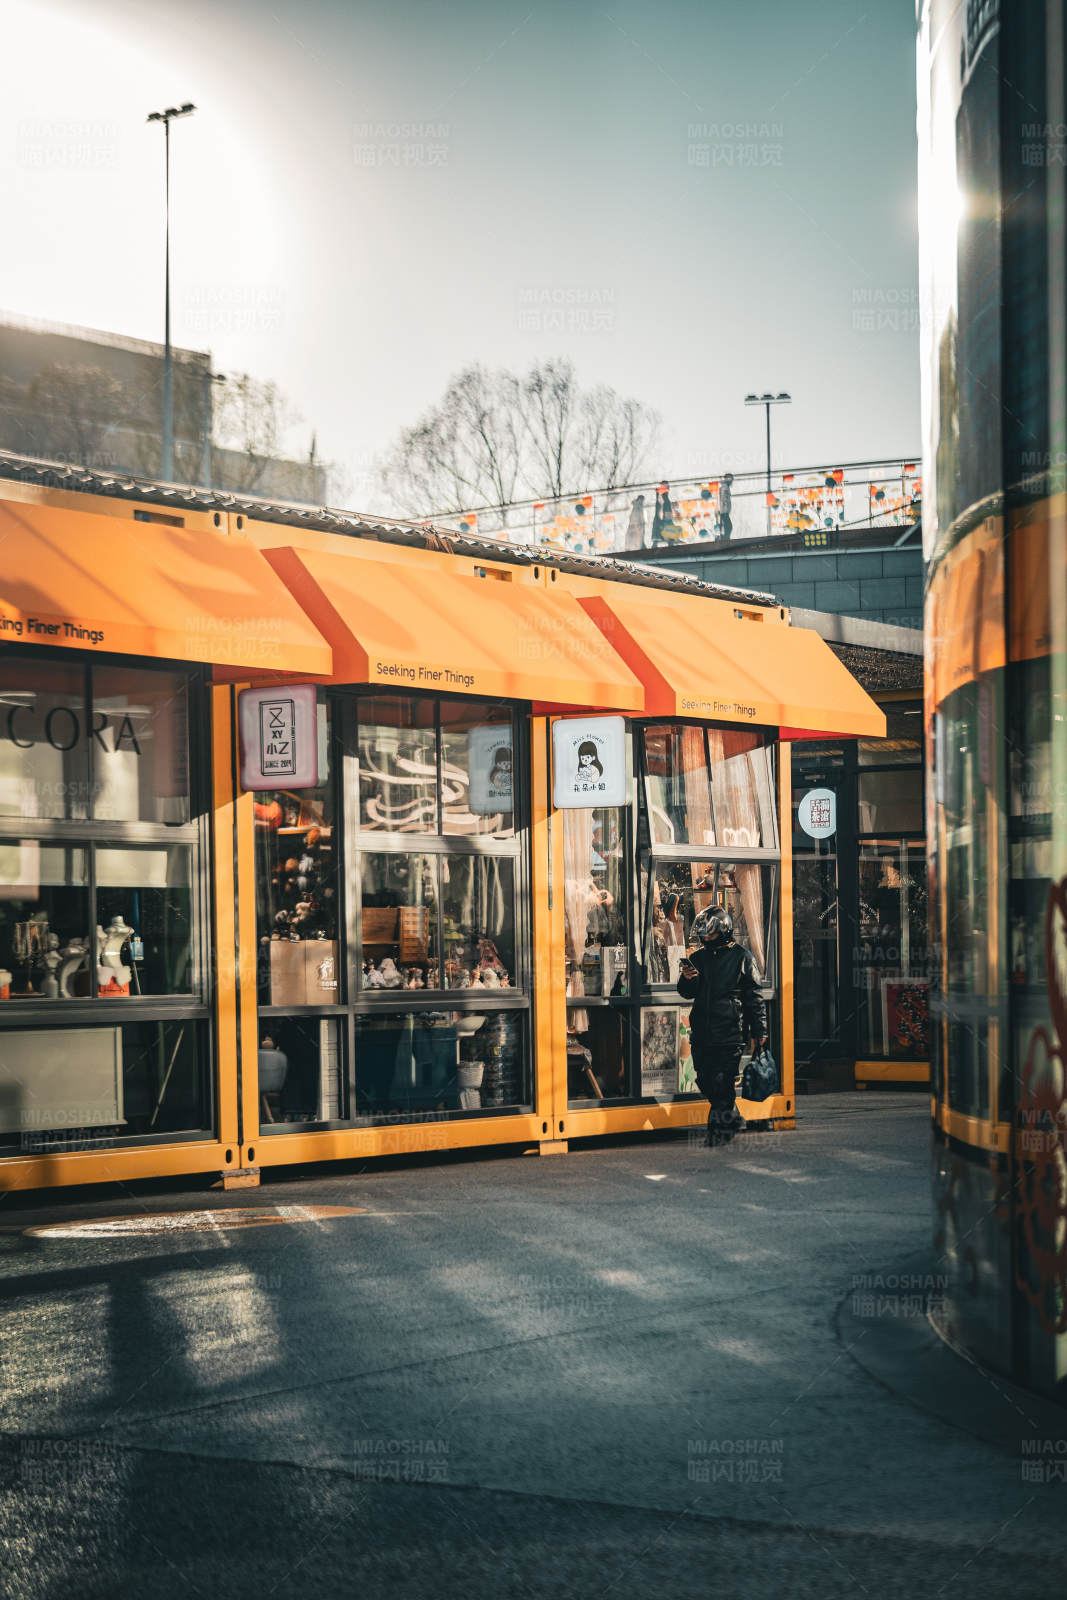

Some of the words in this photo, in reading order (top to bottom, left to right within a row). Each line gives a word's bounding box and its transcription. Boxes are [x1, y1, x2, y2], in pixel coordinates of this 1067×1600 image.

[27, 618, 61, 635] Finer
[62, 621, 105, 645] Things
[376, 662, 416, 681] Seeking
[418, 666, 443, 680] Finer
[444, 669, 475, 688] Things
[681, 698, 712, 714] Seeking
[713, 700, 731, 713] Finer
[733, 703, 756, 718] Things
[7, 705, 142, 755] CORA
[271, 729, 283, 739] XY
